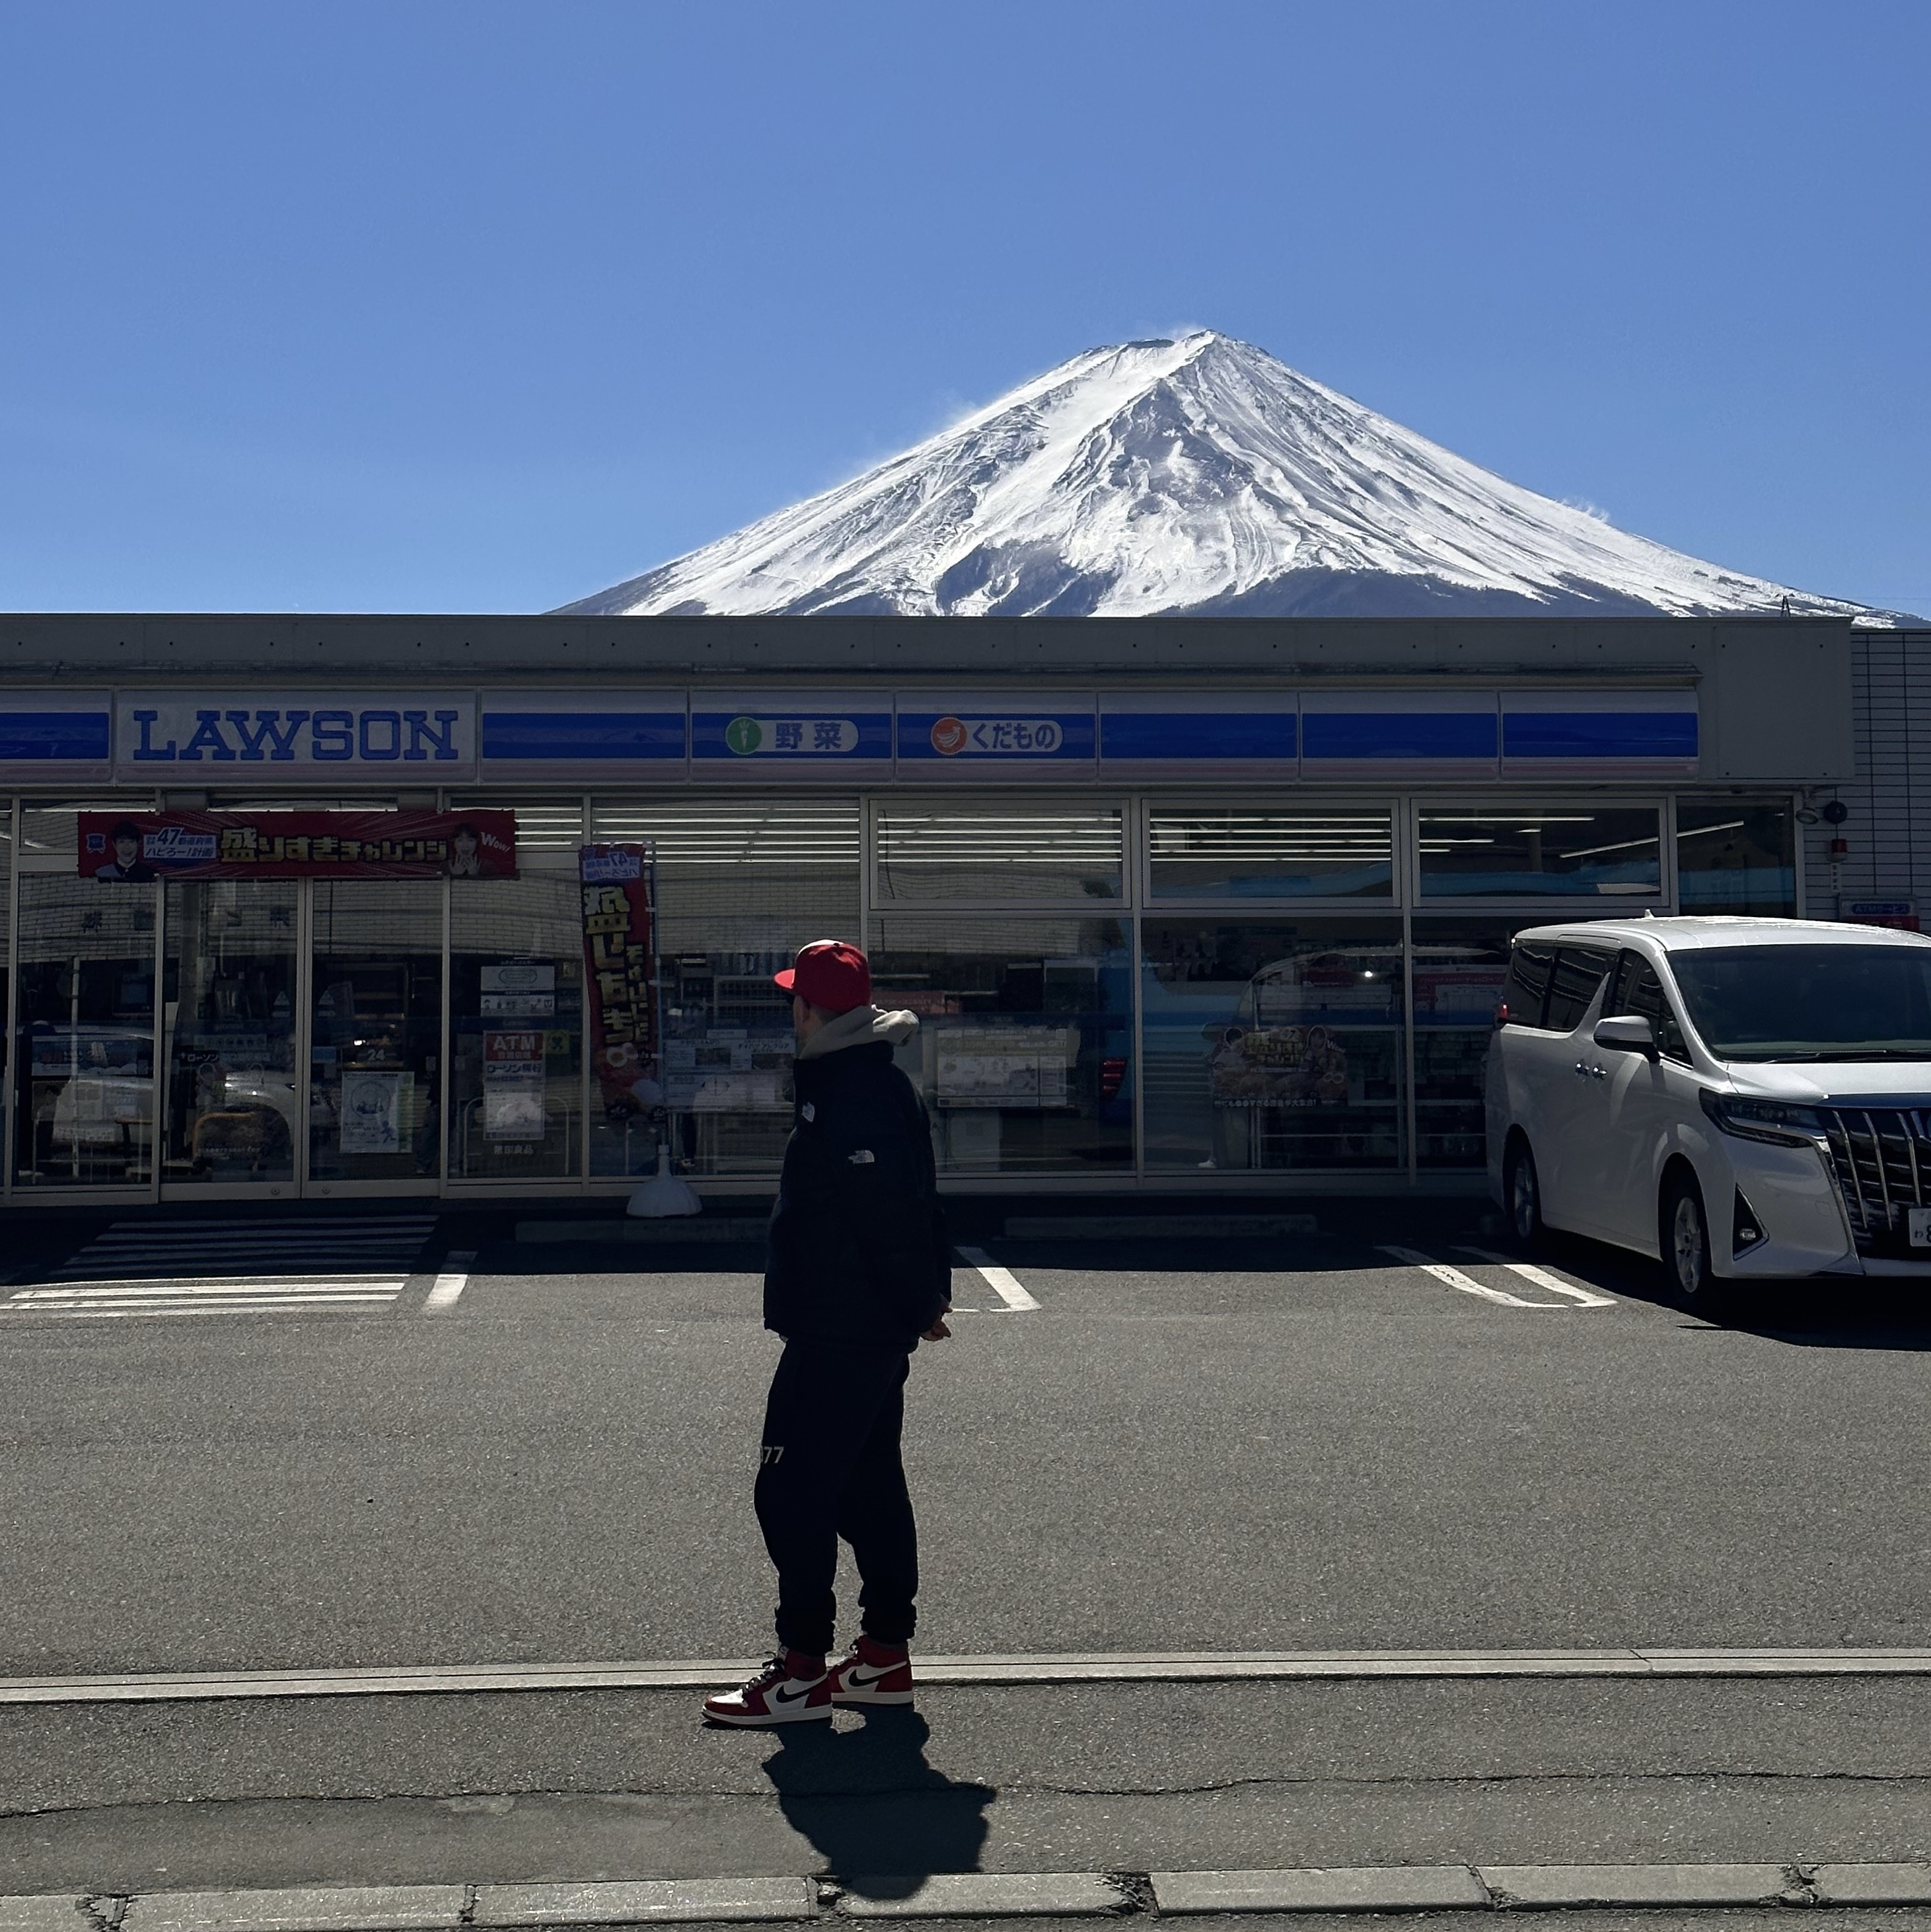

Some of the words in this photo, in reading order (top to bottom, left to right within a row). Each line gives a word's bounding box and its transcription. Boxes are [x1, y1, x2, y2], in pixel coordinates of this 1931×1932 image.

[133, 710, 459, 761] LAWSON
[775, 722, 842, 751] 野菜
[972, 722, 1056, 750] くだもの
[221, 827, 447, 863] 盛りすぎチャレンジ
[492, 1035, 536, 1051] ATM
[367, 1049, 386, 1062] 24
[486, 1063, 542, 1074] ローソン銀行
[761, 1445, 785, 1465] 77
